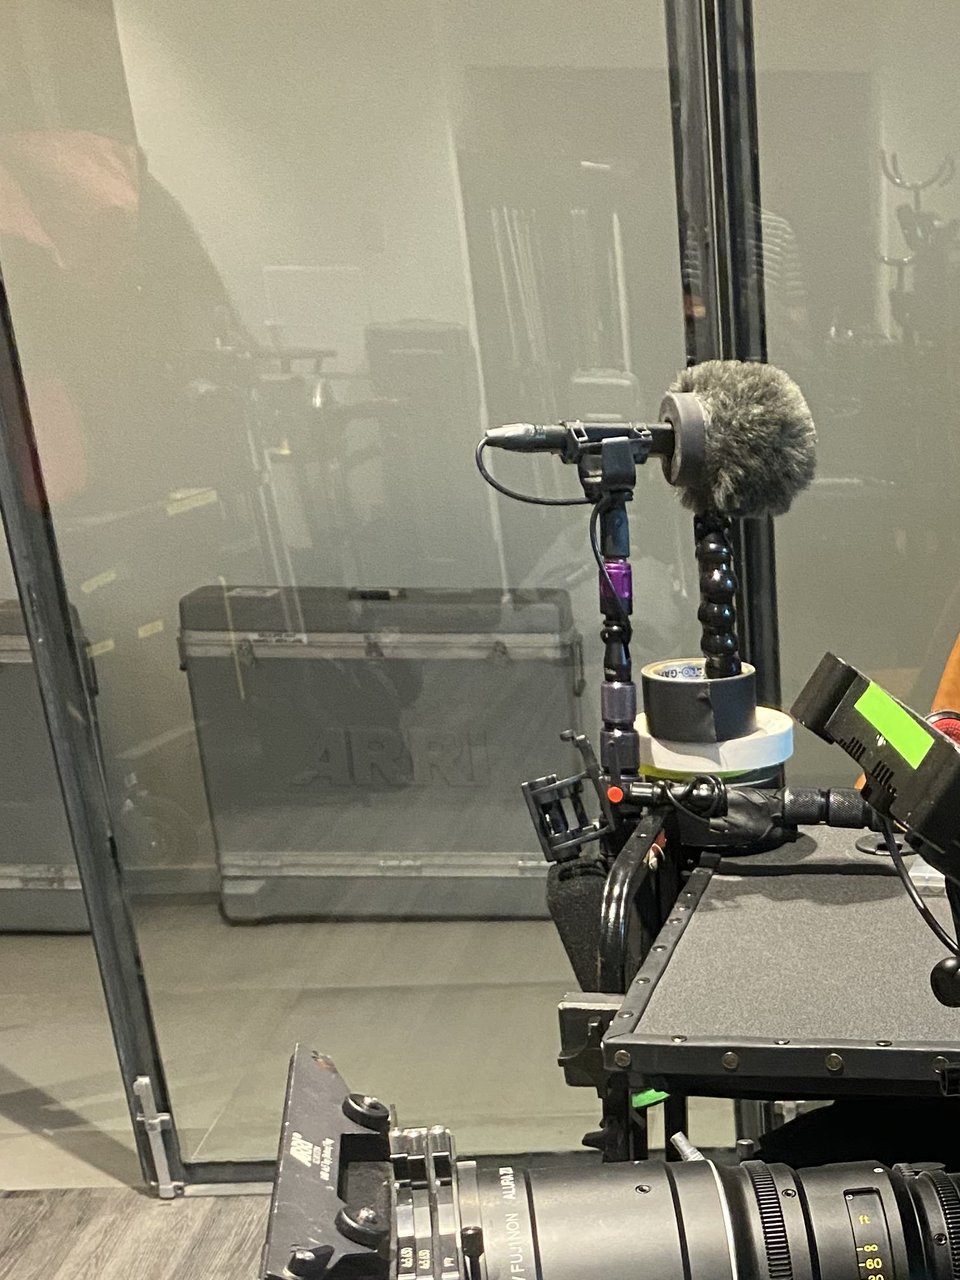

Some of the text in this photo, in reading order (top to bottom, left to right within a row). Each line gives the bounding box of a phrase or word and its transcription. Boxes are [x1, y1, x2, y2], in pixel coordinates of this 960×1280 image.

[291, 728, 488, 787] ARRI
[858, 1215, 871, 1224] ft
[505, 1213, 525, 1273] FUJINON
[865, 1258, 882, 1269] 60
